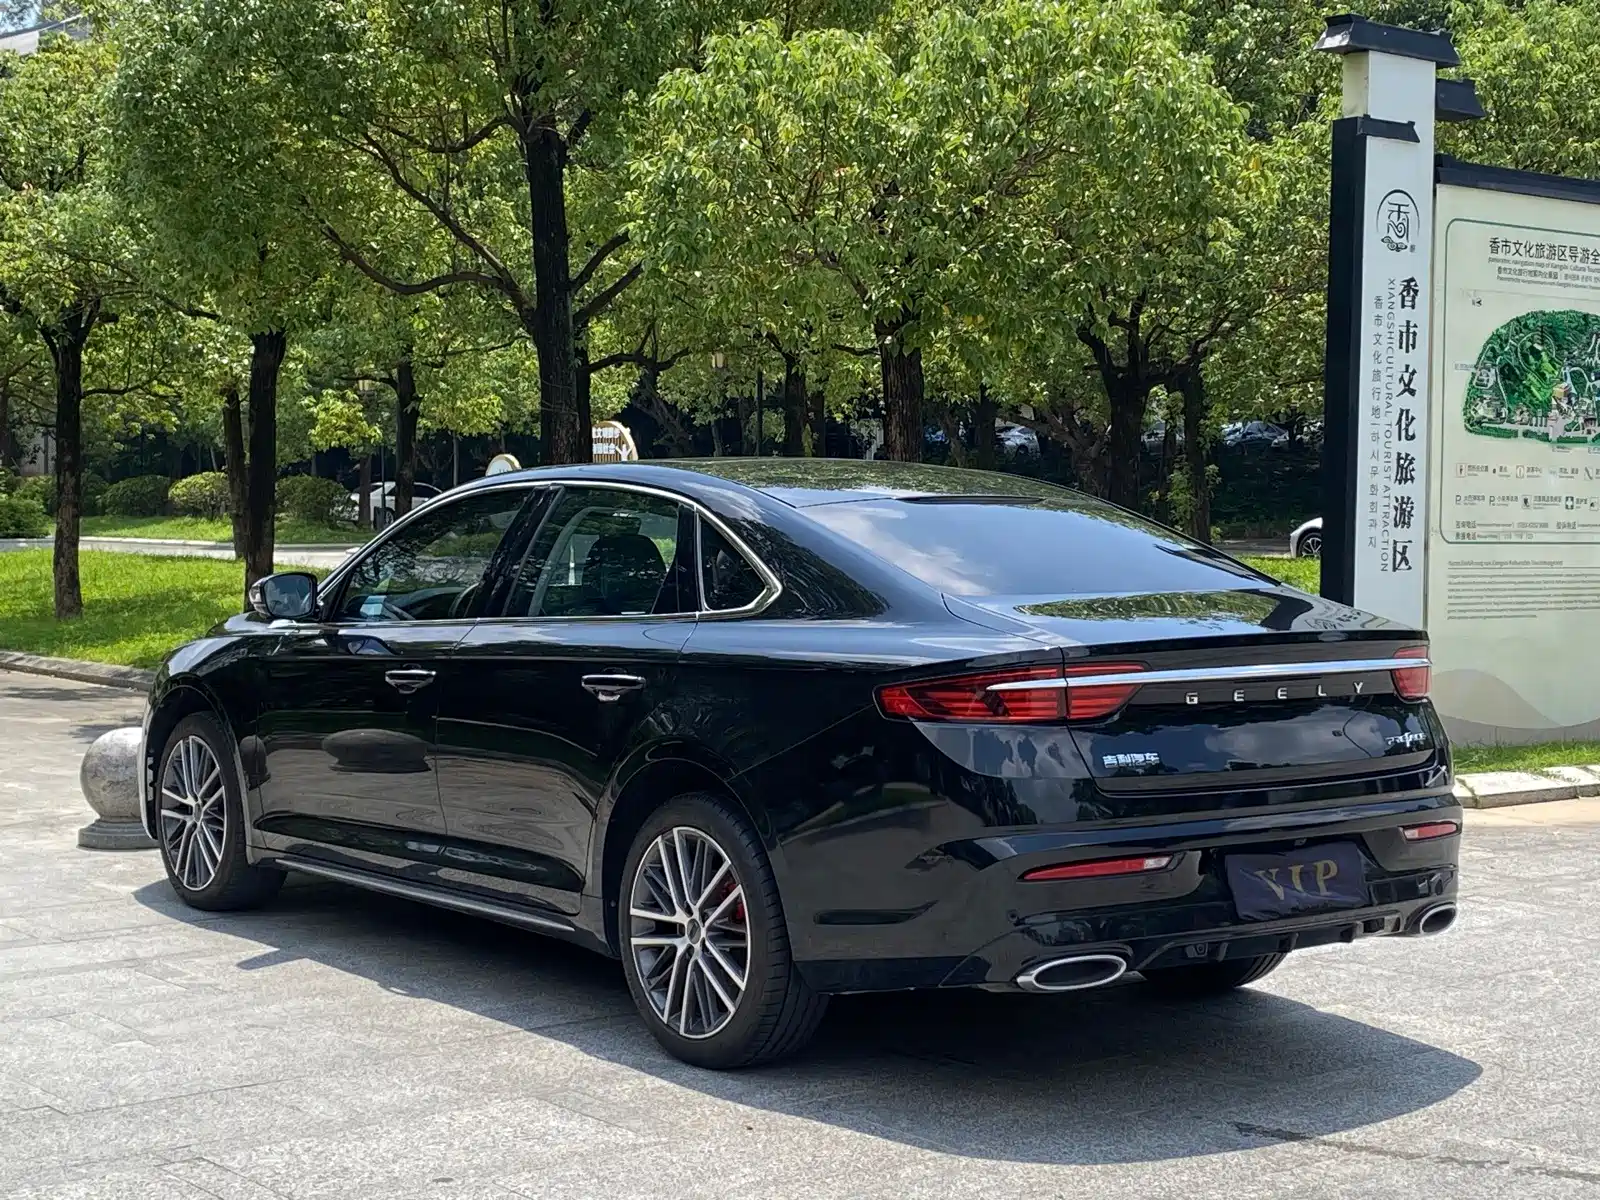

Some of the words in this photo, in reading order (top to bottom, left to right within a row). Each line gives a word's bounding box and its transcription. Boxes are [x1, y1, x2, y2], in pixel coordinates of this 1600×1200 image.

[1391, 276, 1420, 573] 香市文化旅游区
[1383, 422, 1393, 482] TOURIST
[1381, 484, 1391, 572] ATTRACTION
[1185, 681, 1364, 705] GEELY
[1102, 752, 1160, 769] 吉利汽车
[1253, 858, 1339, 900] VIP
